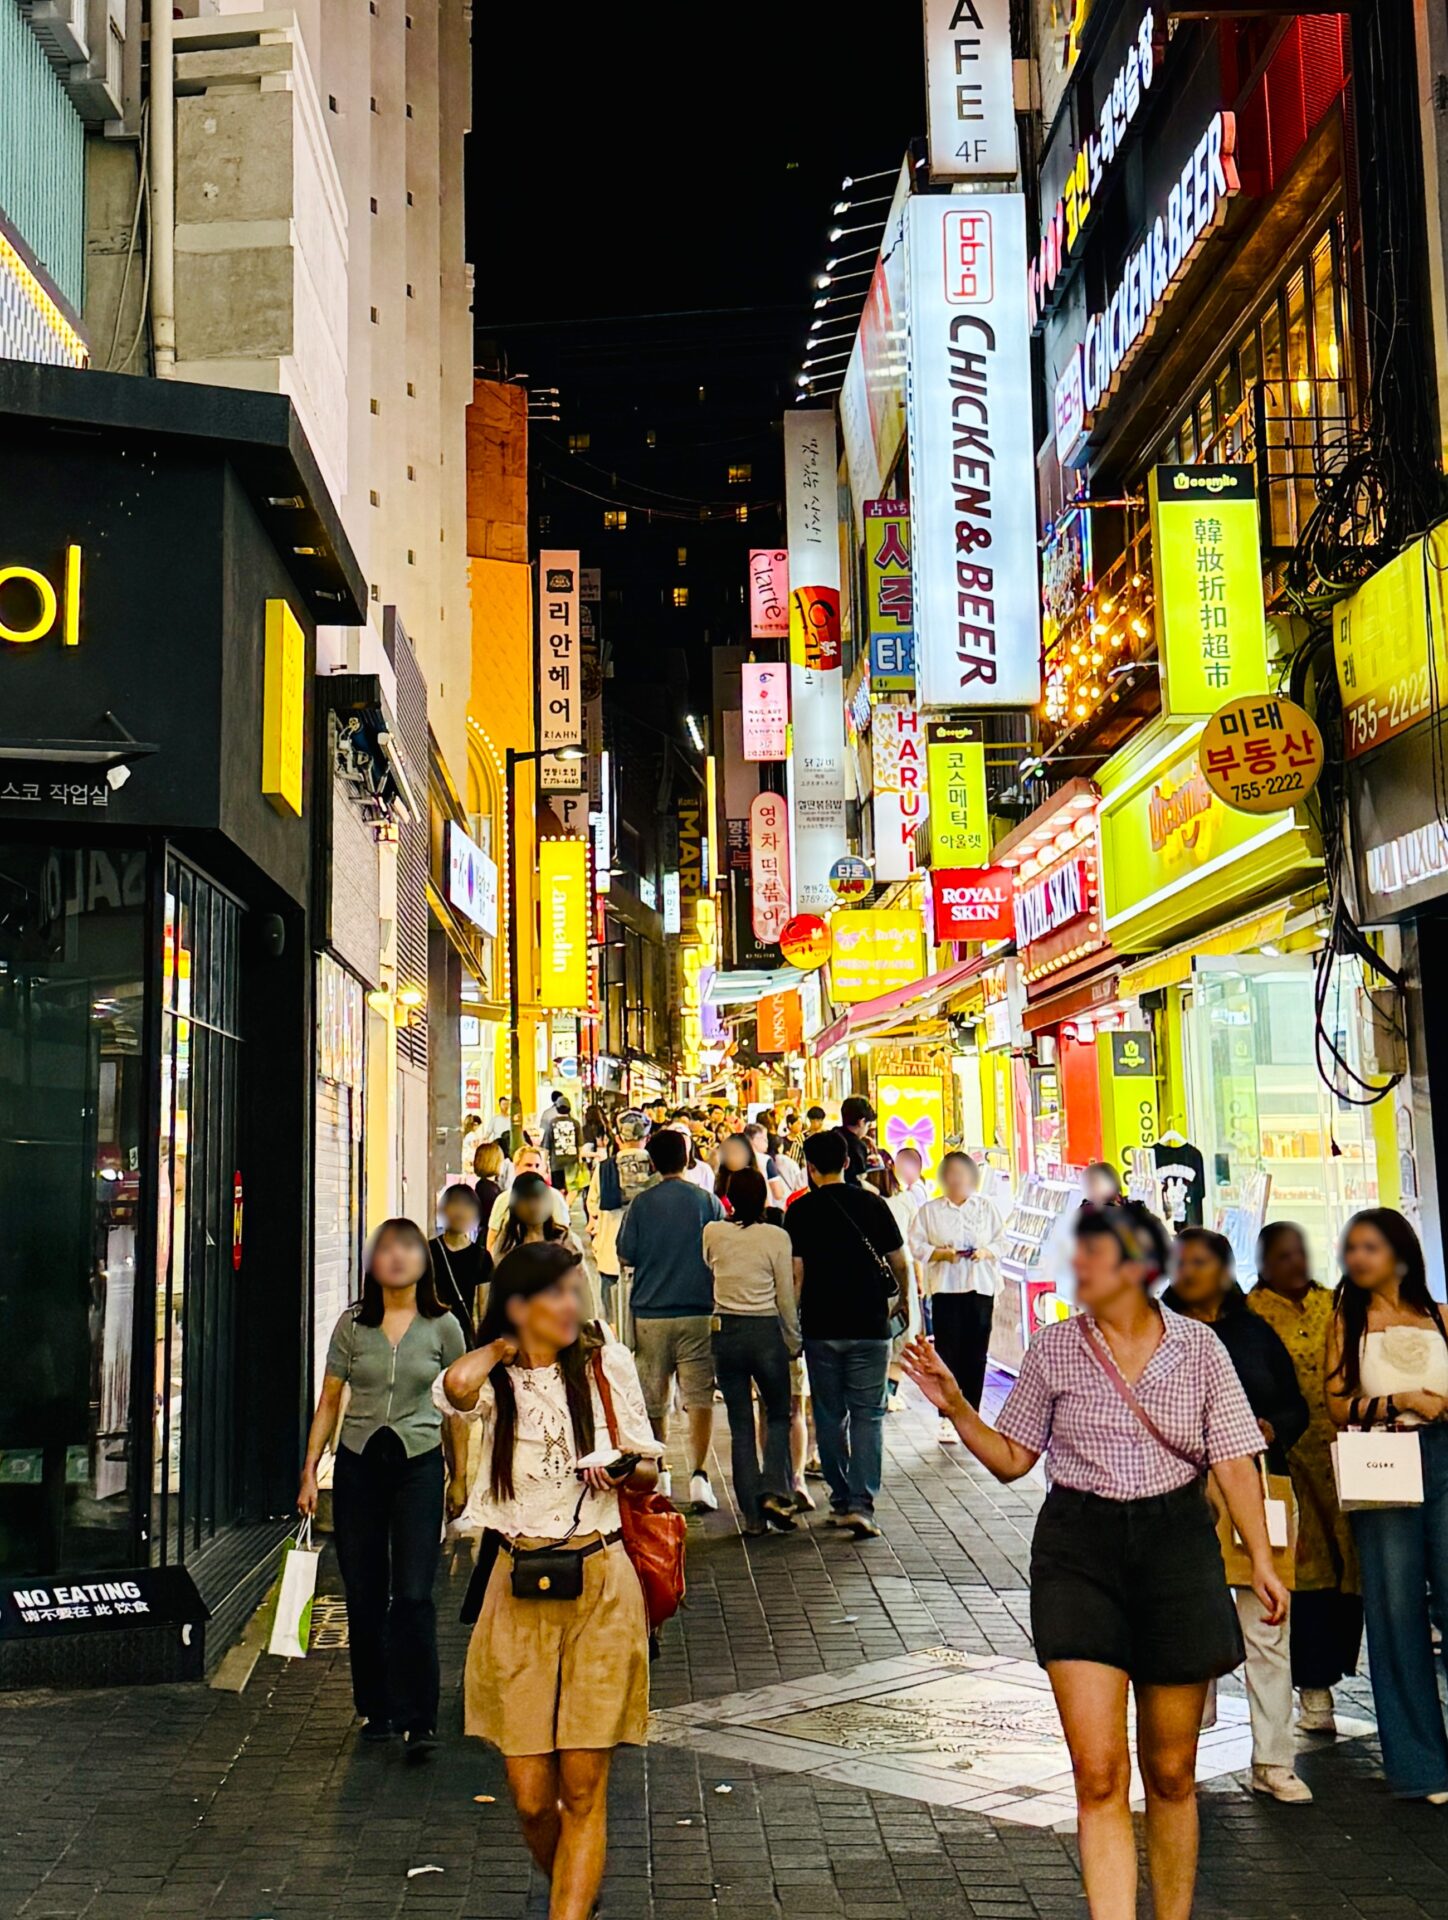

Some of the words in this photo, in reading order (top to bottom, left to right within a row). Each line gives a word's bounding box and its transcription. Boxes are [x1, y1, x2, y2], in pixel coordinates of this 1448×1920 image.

[955, 140, 988, 163] 4F
[1194, 518, 1232, 689] 韓妝折扣超市
[548, 601, 572, 723] 리안헤어
[876, 637, 915, 672] 타
[1219, 701, 1284, 737] 미래
[1349, 665, 1431, 750] 755-2222
[544, 730, 578, 739] RIAHN
[1206, 729, 1316, 782] 부동산
[50, 783, 109, 807] 작업실
[897, 711, 919, 872] HARUKI
[947, 752, 968, 829] 코스메틱
[1230, 771, 1305, 802] 755-2222
[678, 810, 701, 903] MART
[940, 834, 982, 849] 아울렛
[837, 864, 864, 877] 타로
[942, 887, 1008, 904] ROYAL
[951, 904, 999, 921] SKIN
[1013, 880, 1053, 950] ROYAL
[1049, 856, 1081, 929] SKIN
[1139, 1100, 1154, 1149] COS
[13, 1589, 50, 1608] NO
[53, 1581, 141, 1605] EATING
